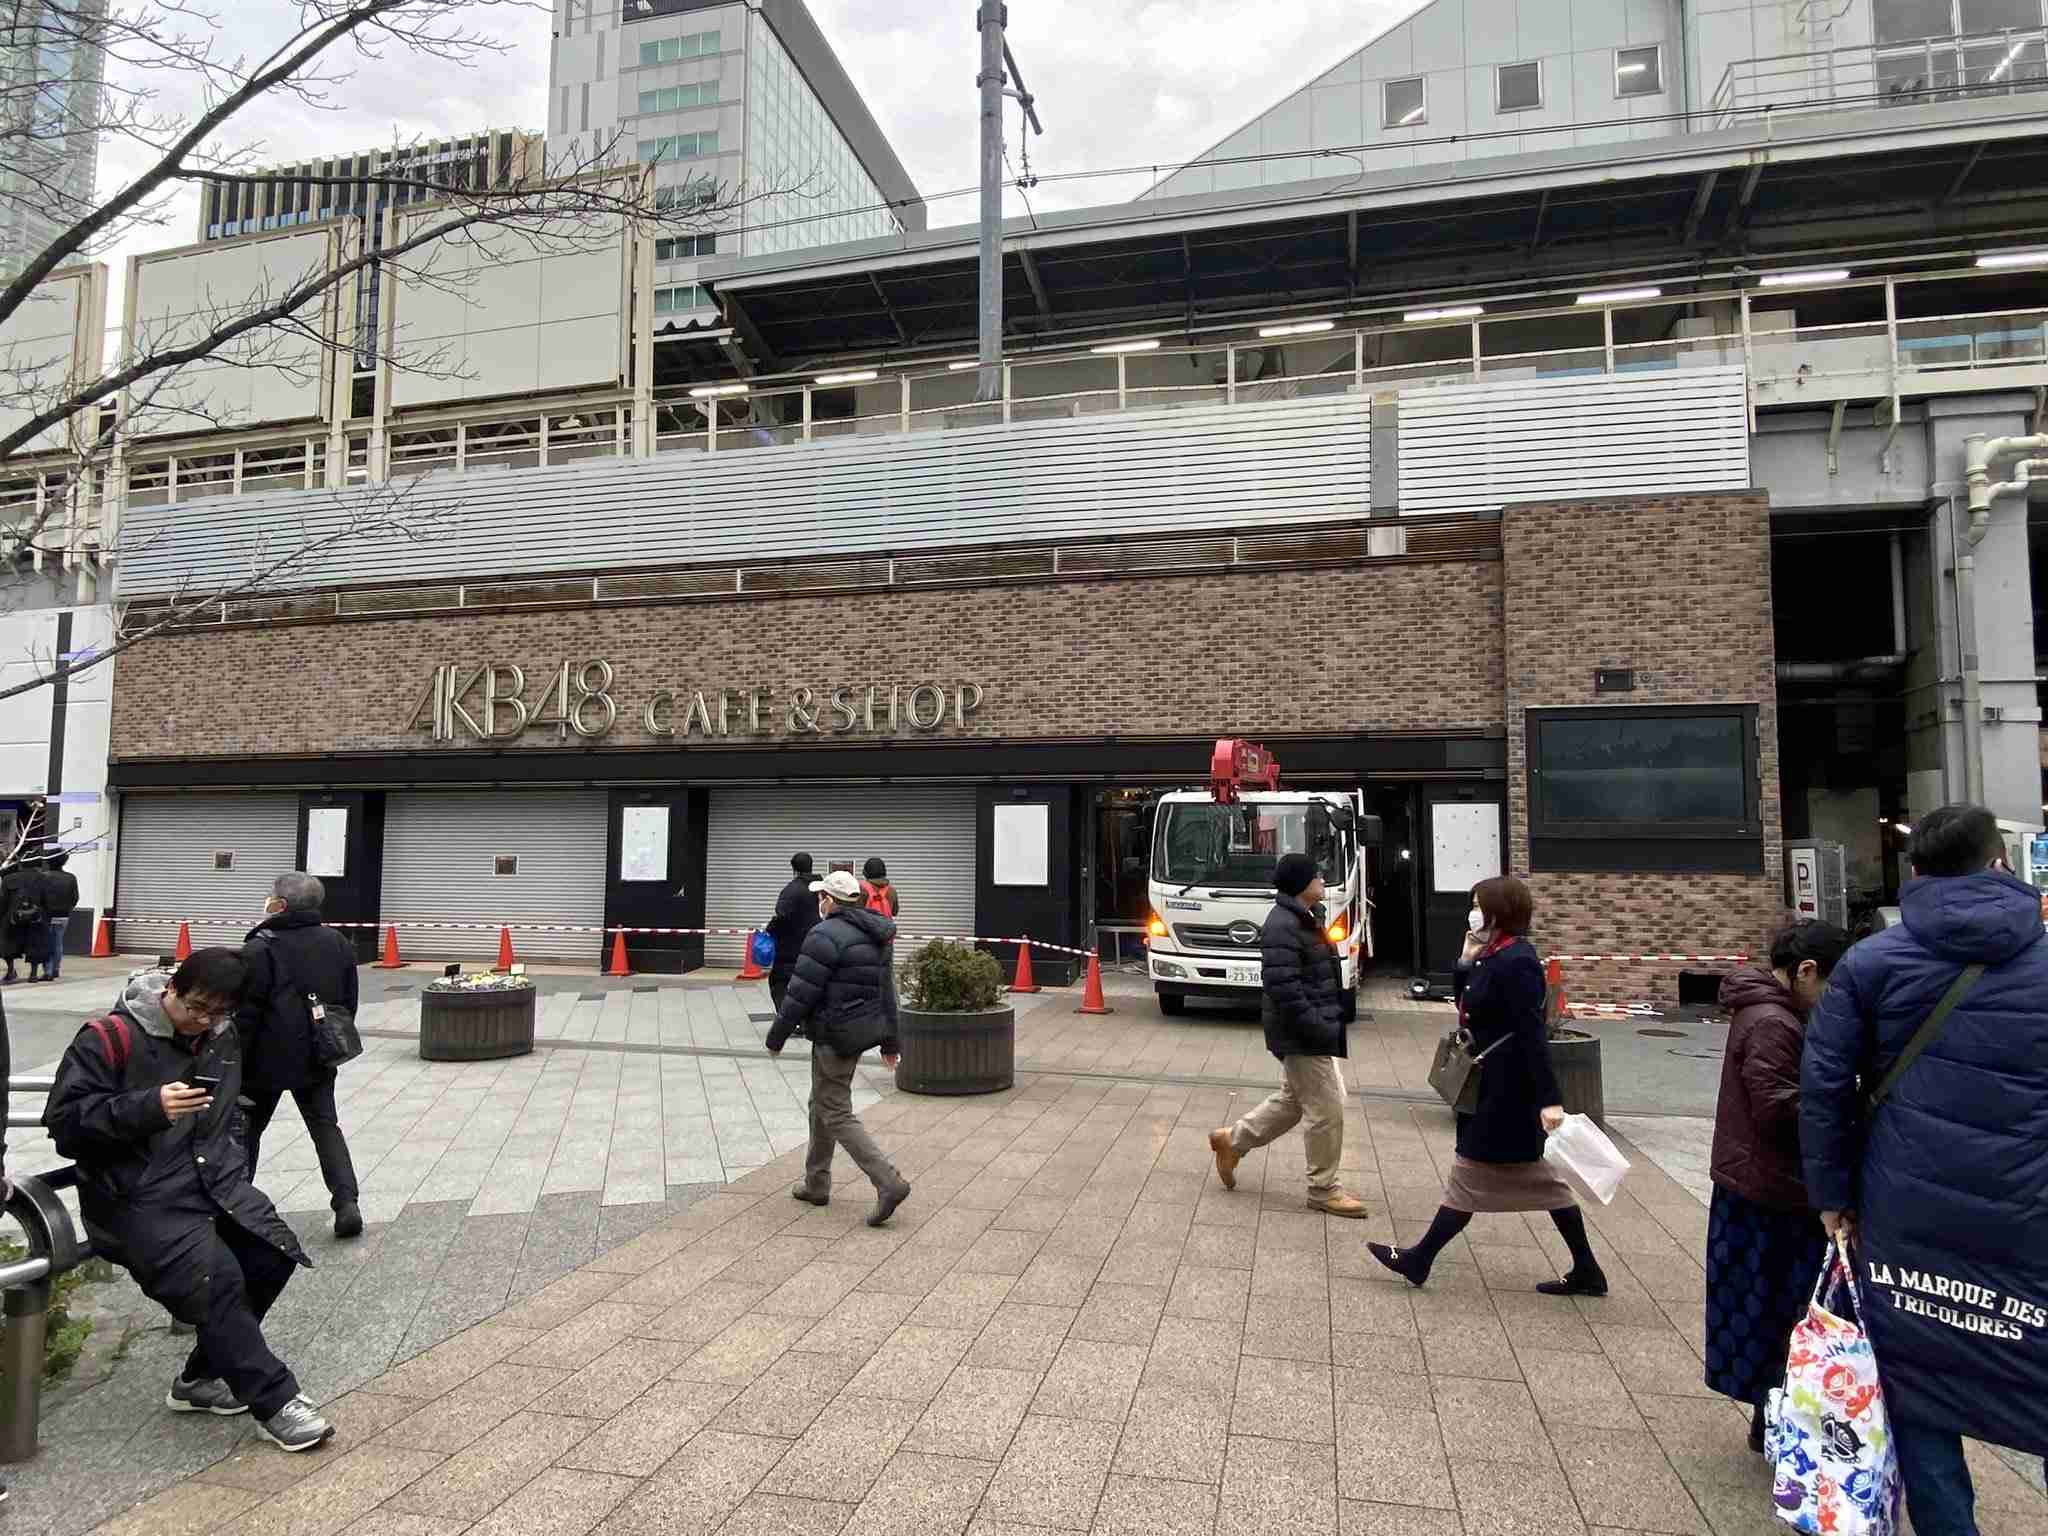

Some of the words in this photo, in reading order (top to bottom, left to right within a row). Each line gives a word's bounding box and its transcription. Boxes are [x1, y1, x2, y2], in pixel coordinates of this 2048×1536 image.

[407, 658, 616, 740] AKB48
[784, 687, 822, 733] &
[831, 681, 984, 732] SHOP
[1868, 1262, 1895, 1285] LA
[1899, 1267, 1997, 1310] MARQUE
[2001, 1296, 2048, 1328] DES
[1891, 1290, 2024, 1340] TRICOLORES
